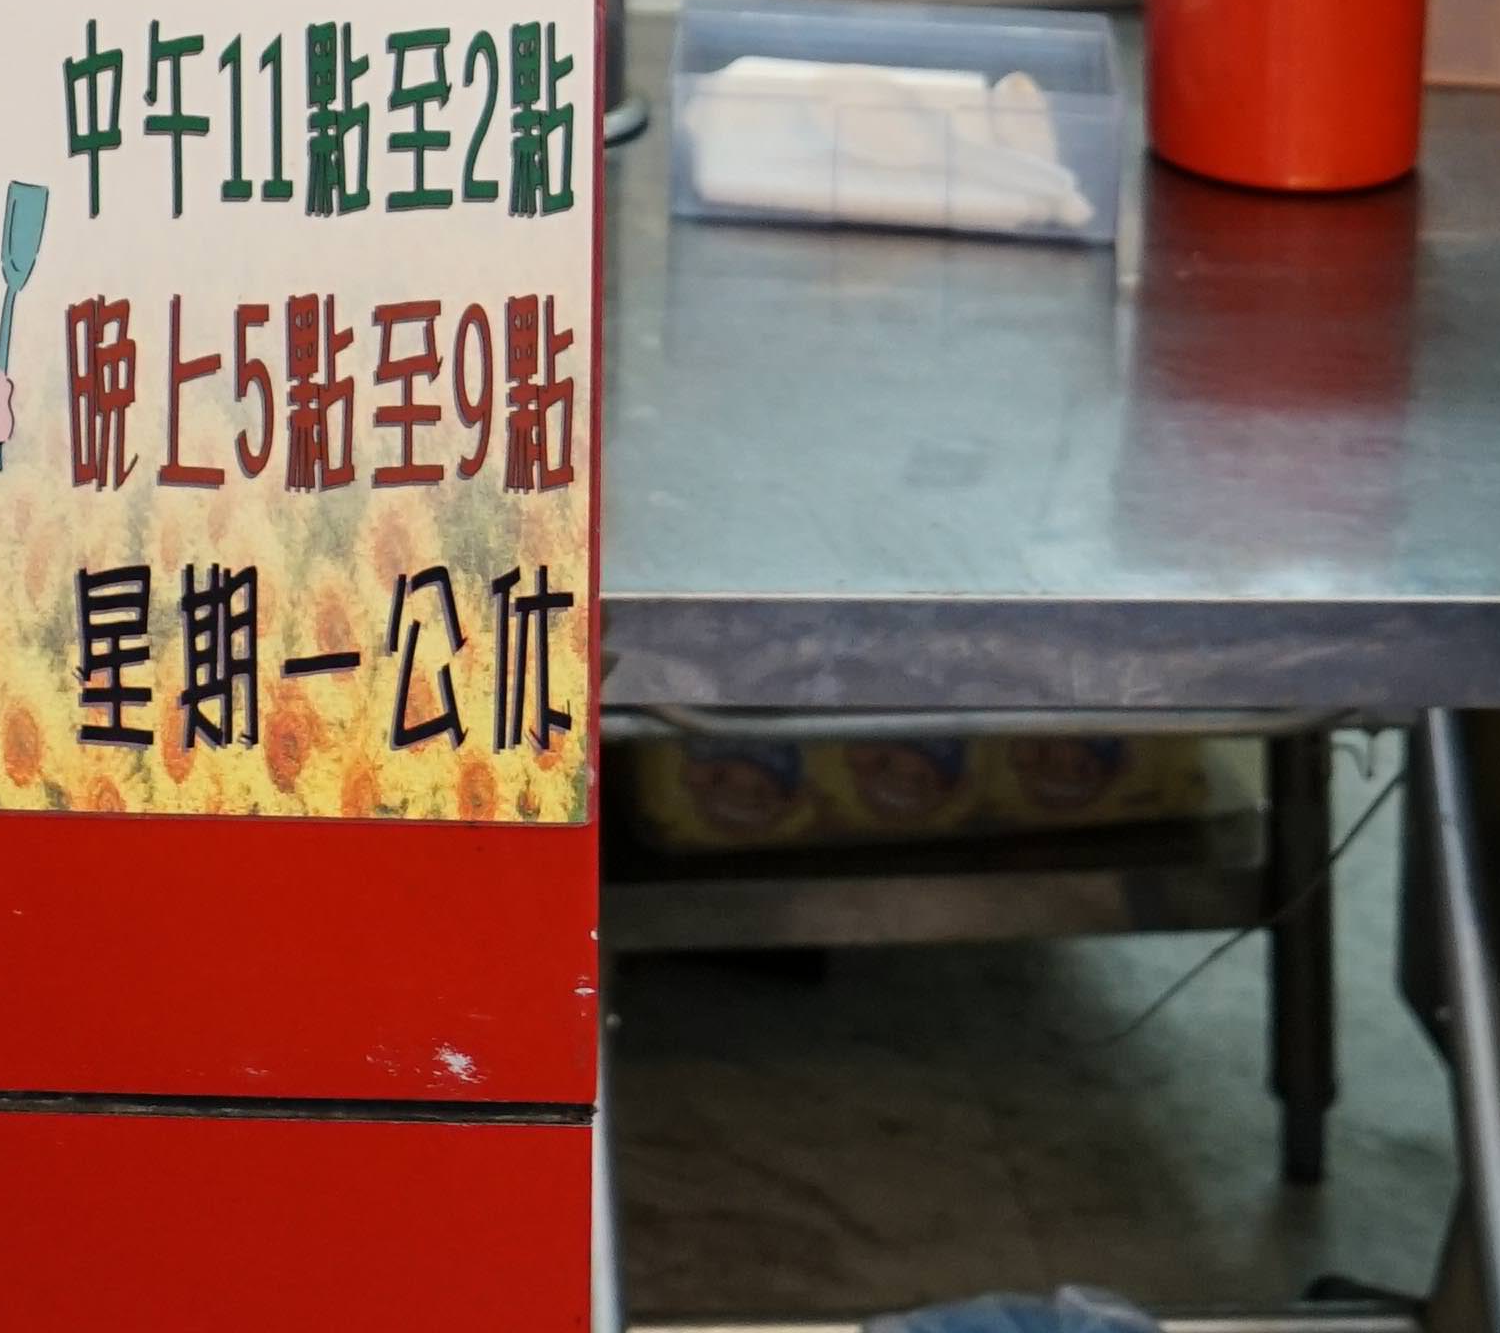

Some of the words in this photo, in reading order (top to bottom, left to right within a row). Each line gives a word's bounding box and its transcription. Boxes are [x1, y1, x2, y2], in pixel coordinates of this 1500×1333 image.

[63, 19, 576, 221] 中午11點至2點
[68, 294, 576, 495] 晚上5點至9點
[76, 563, 574, 753] 星期一公休
